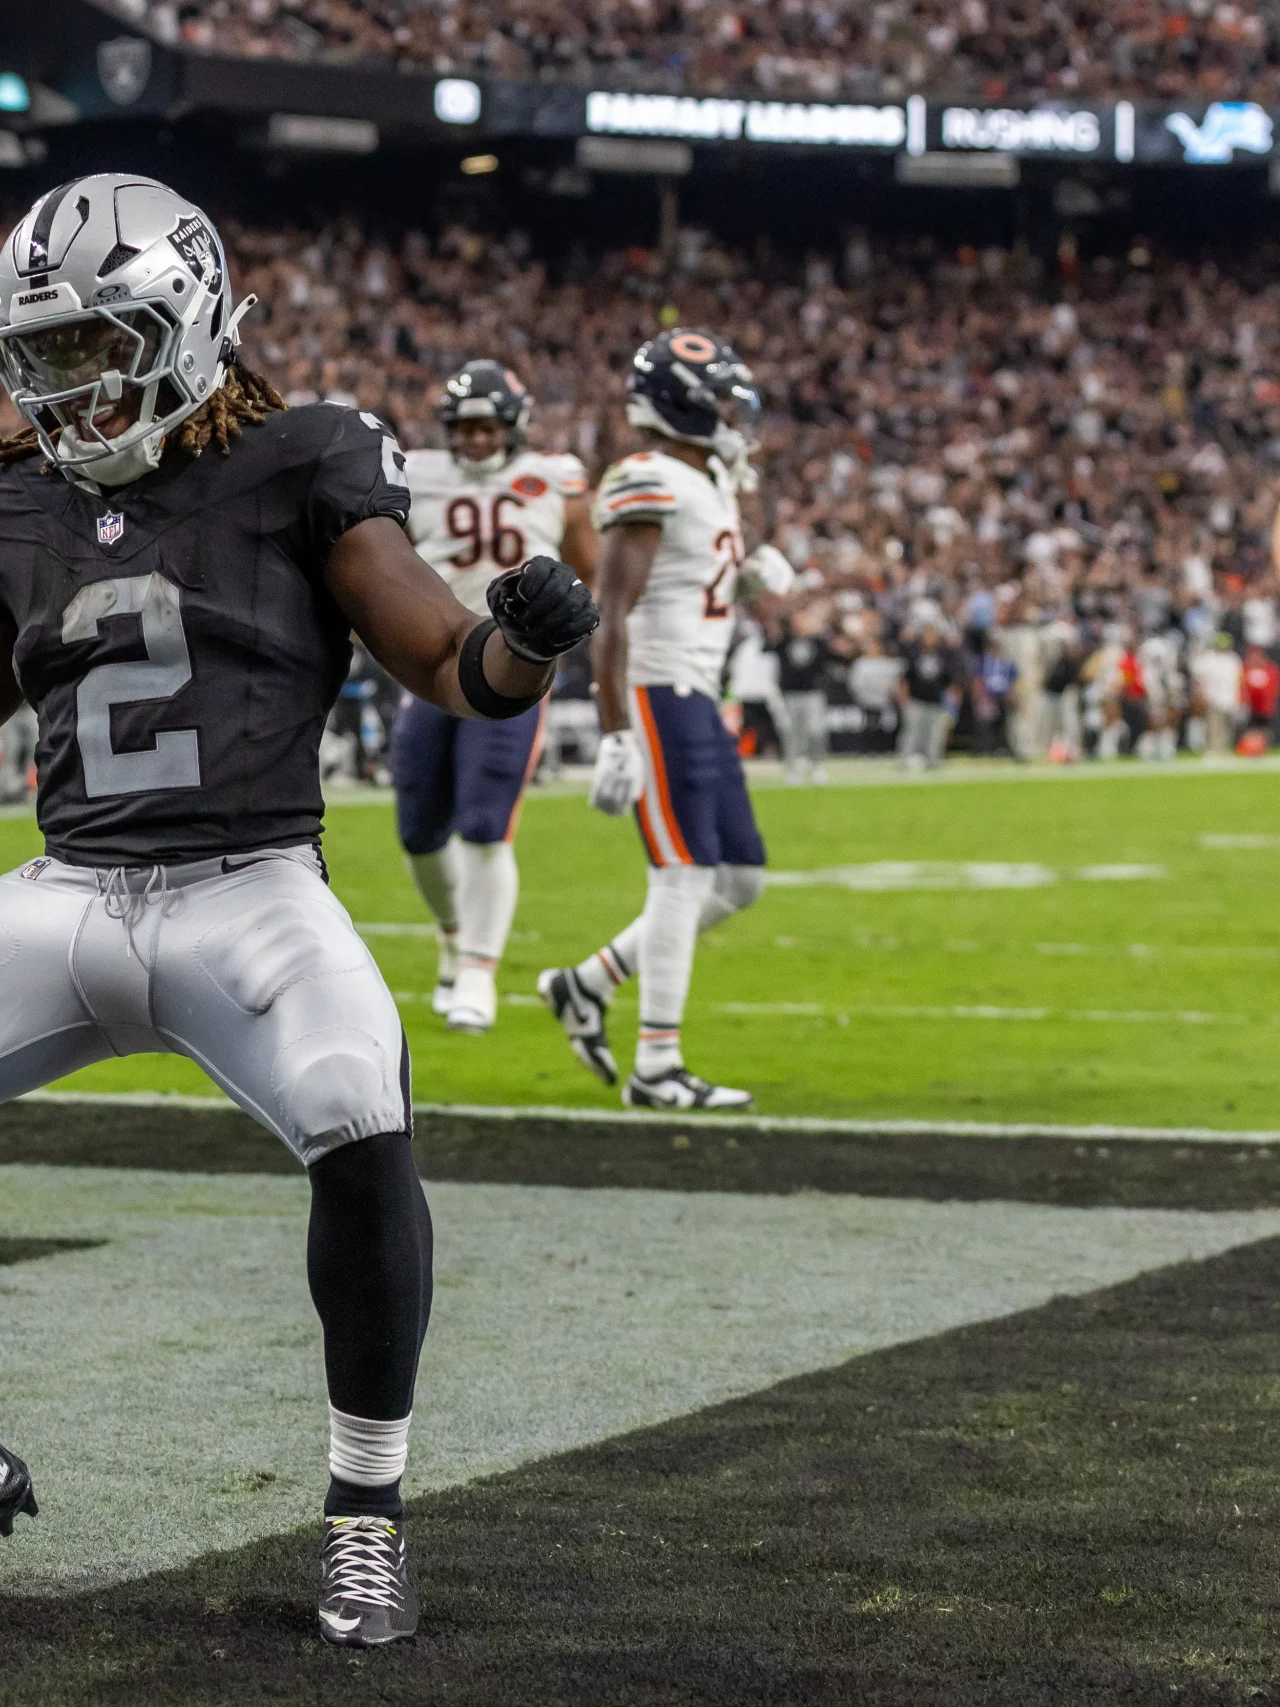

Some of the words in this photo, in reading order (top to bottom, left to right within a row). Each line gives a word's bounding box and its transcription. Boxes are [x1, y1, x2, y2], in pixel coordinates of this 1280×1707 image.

[172, 218, 202, 244] RAIDERS
[18, 289, 59, 306] RAIDERS
[92, 291, 129, 307] OAKLEY
[101, 524, 120, 539] NFL
[446, 492, 526, 571] 96
[61, 570, 202, 799] 2
